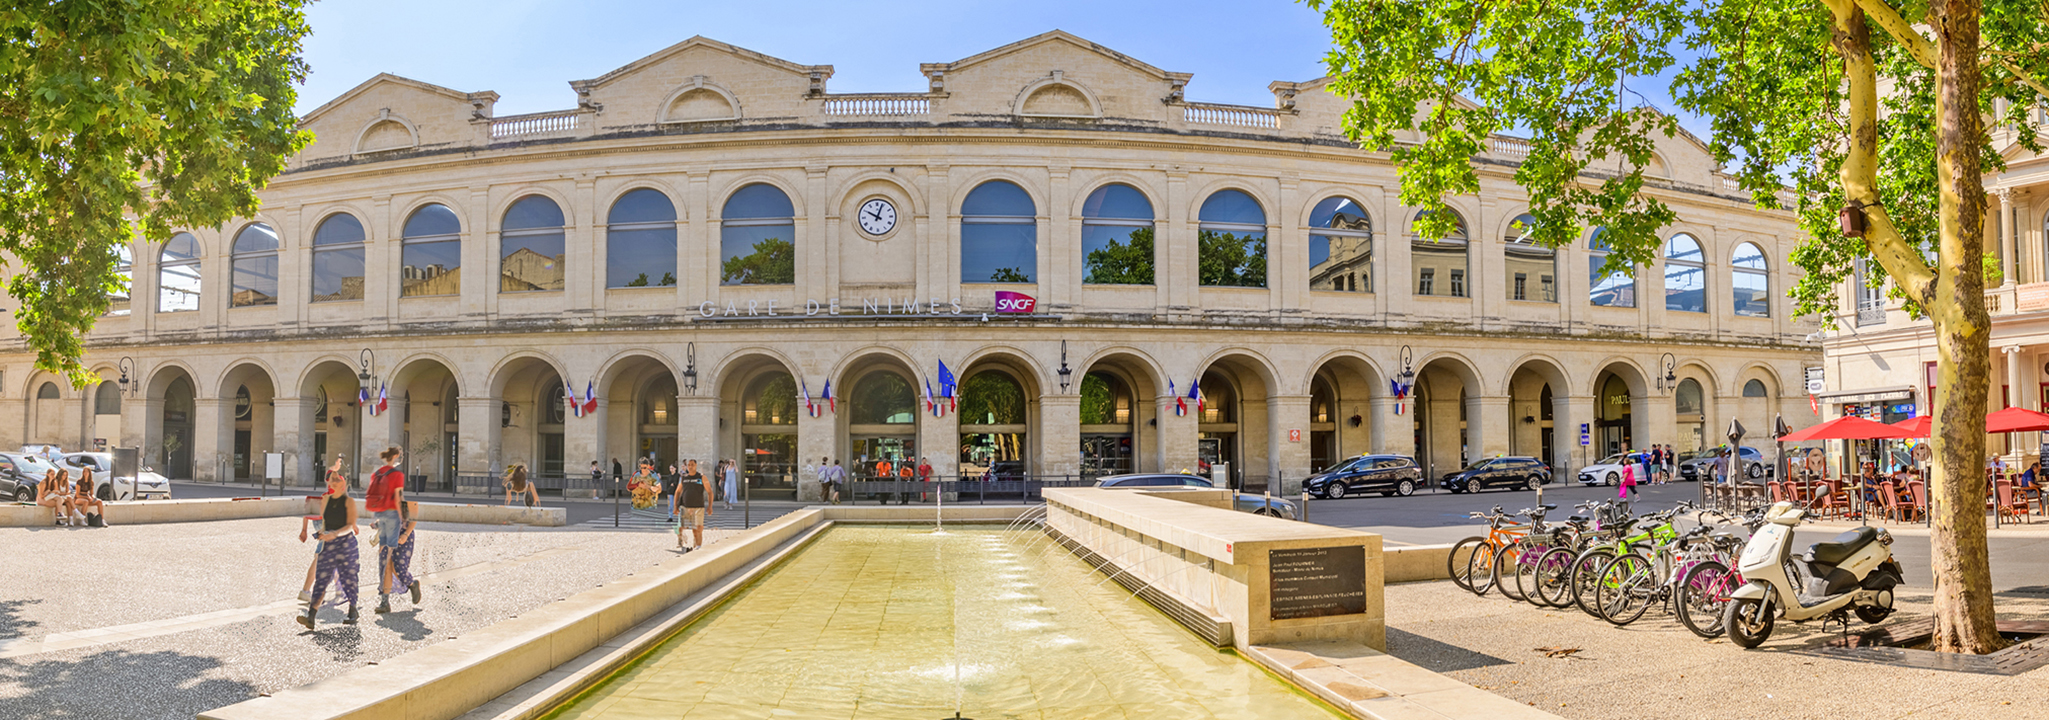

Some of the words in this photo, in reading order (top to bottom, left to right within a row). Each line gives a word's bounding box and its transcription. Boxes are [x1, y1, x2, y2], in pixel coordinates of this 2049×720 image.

[699, 299, 778, 318] GARE
[806, 298, 839, 316] DE
[863, 297, 962, 315] NIMES
[997, 298, 1034, 311] SNCF
[1610, 394, 1630, 405] PAUL
